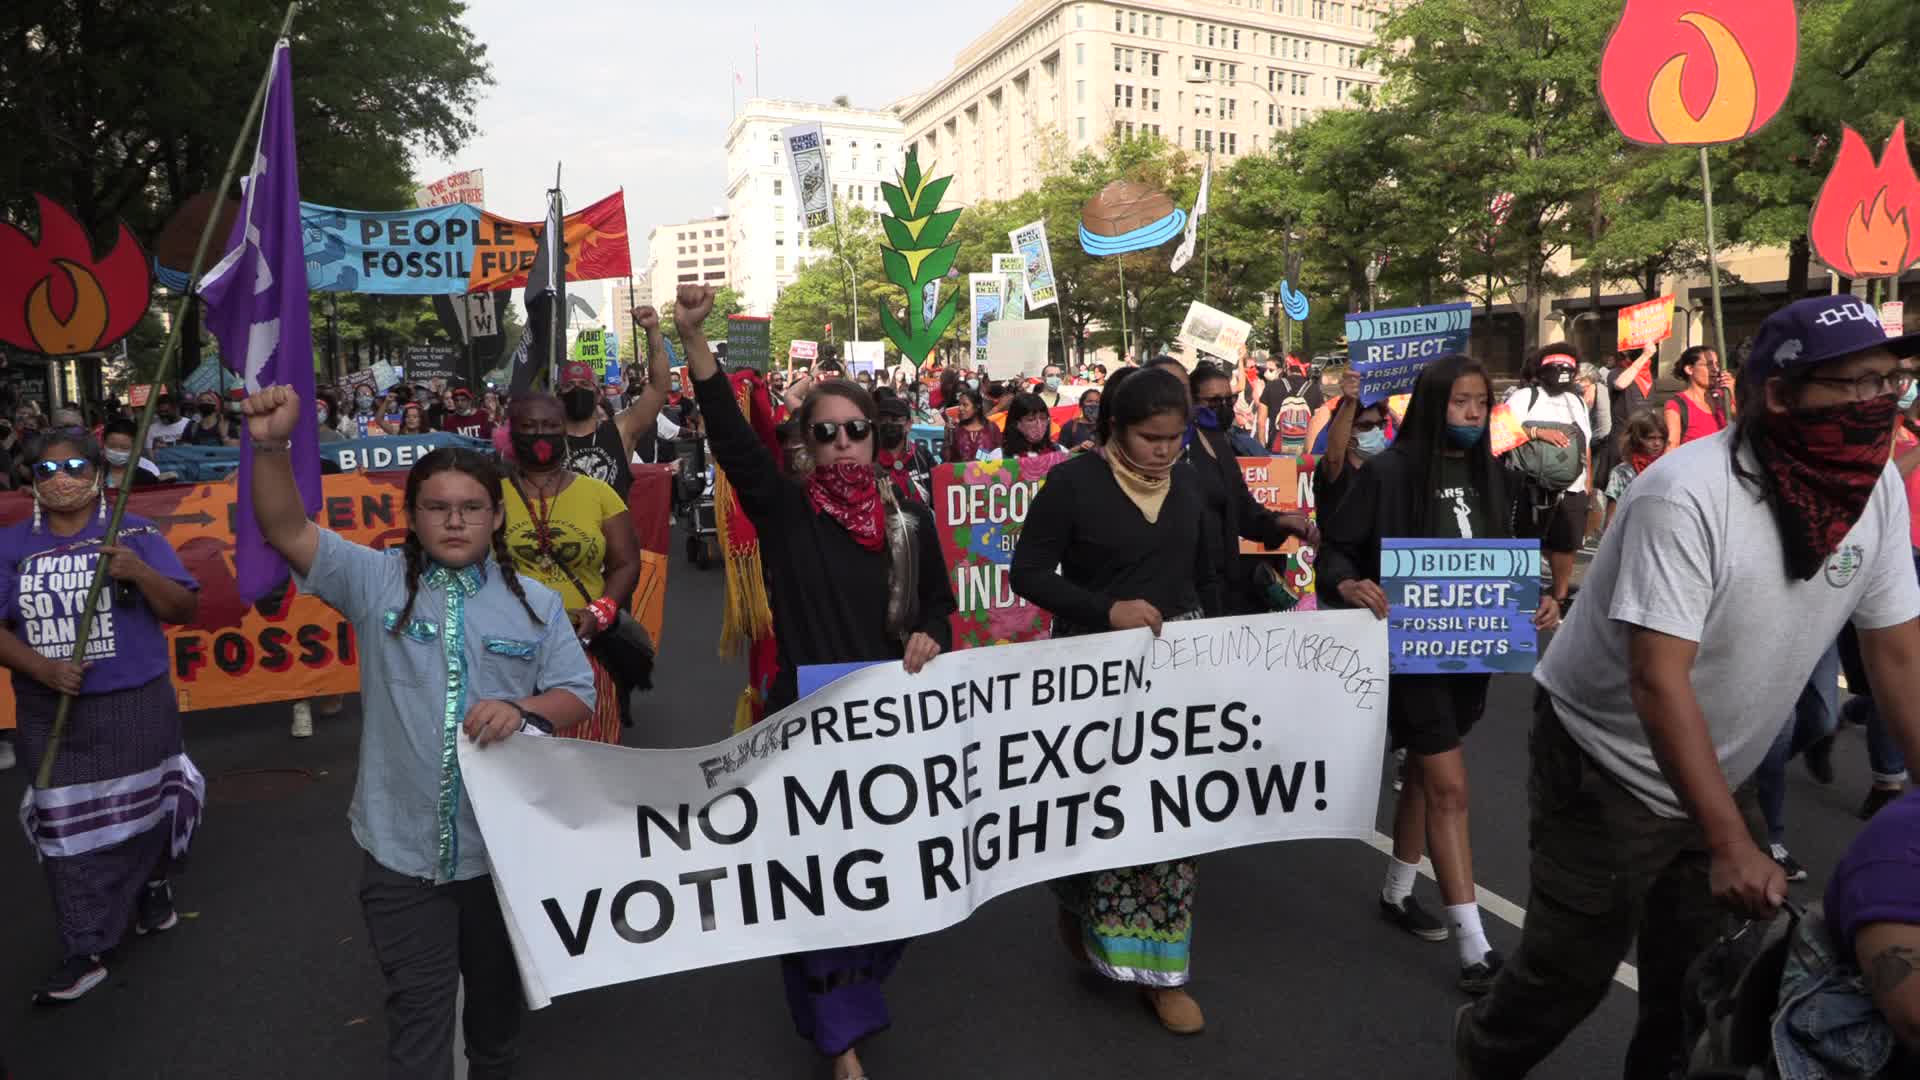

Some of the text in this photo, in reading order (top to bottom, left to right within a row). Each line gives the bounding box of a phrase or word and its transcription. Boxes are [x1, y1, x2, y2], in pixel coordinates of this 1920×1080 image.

[427, 180, 446, 196] THE
[361, 218, 514, 246] PEOPLE
[362, 250, 470, 278] FOSSIL
[578, 330, 601, 343] PLANET
[1380, 317, 1437, 336] BIDEN
[582, 344, 599, 356] OVER
[1367, 338, 1447, 363] REJECT
[1363, 376, 1416, 395] PROJE
[457, 425, 481, 438] MIT
[1422, 553, 1495, 571] BIDEN
[20, 574, 44, 592] BE
[18, 592, 53, 619] SO
[1403, 583, 1511, 608] REJECT
[26, 617, 77, 645] CAN
[1402, 616, 1509, 631] FOSSIL FUEL
[174, 621, 355, 682] FOSSI
[1402, 639, 1509, 656] PROJECTS
[781, 656, 1152, 751] PRESIDENT BIDEN,
[637, 702, 1262, 858] NO MORE EXCUSES:
[541, 760, 1327, 957] VOTING RIGHTS NOW!
